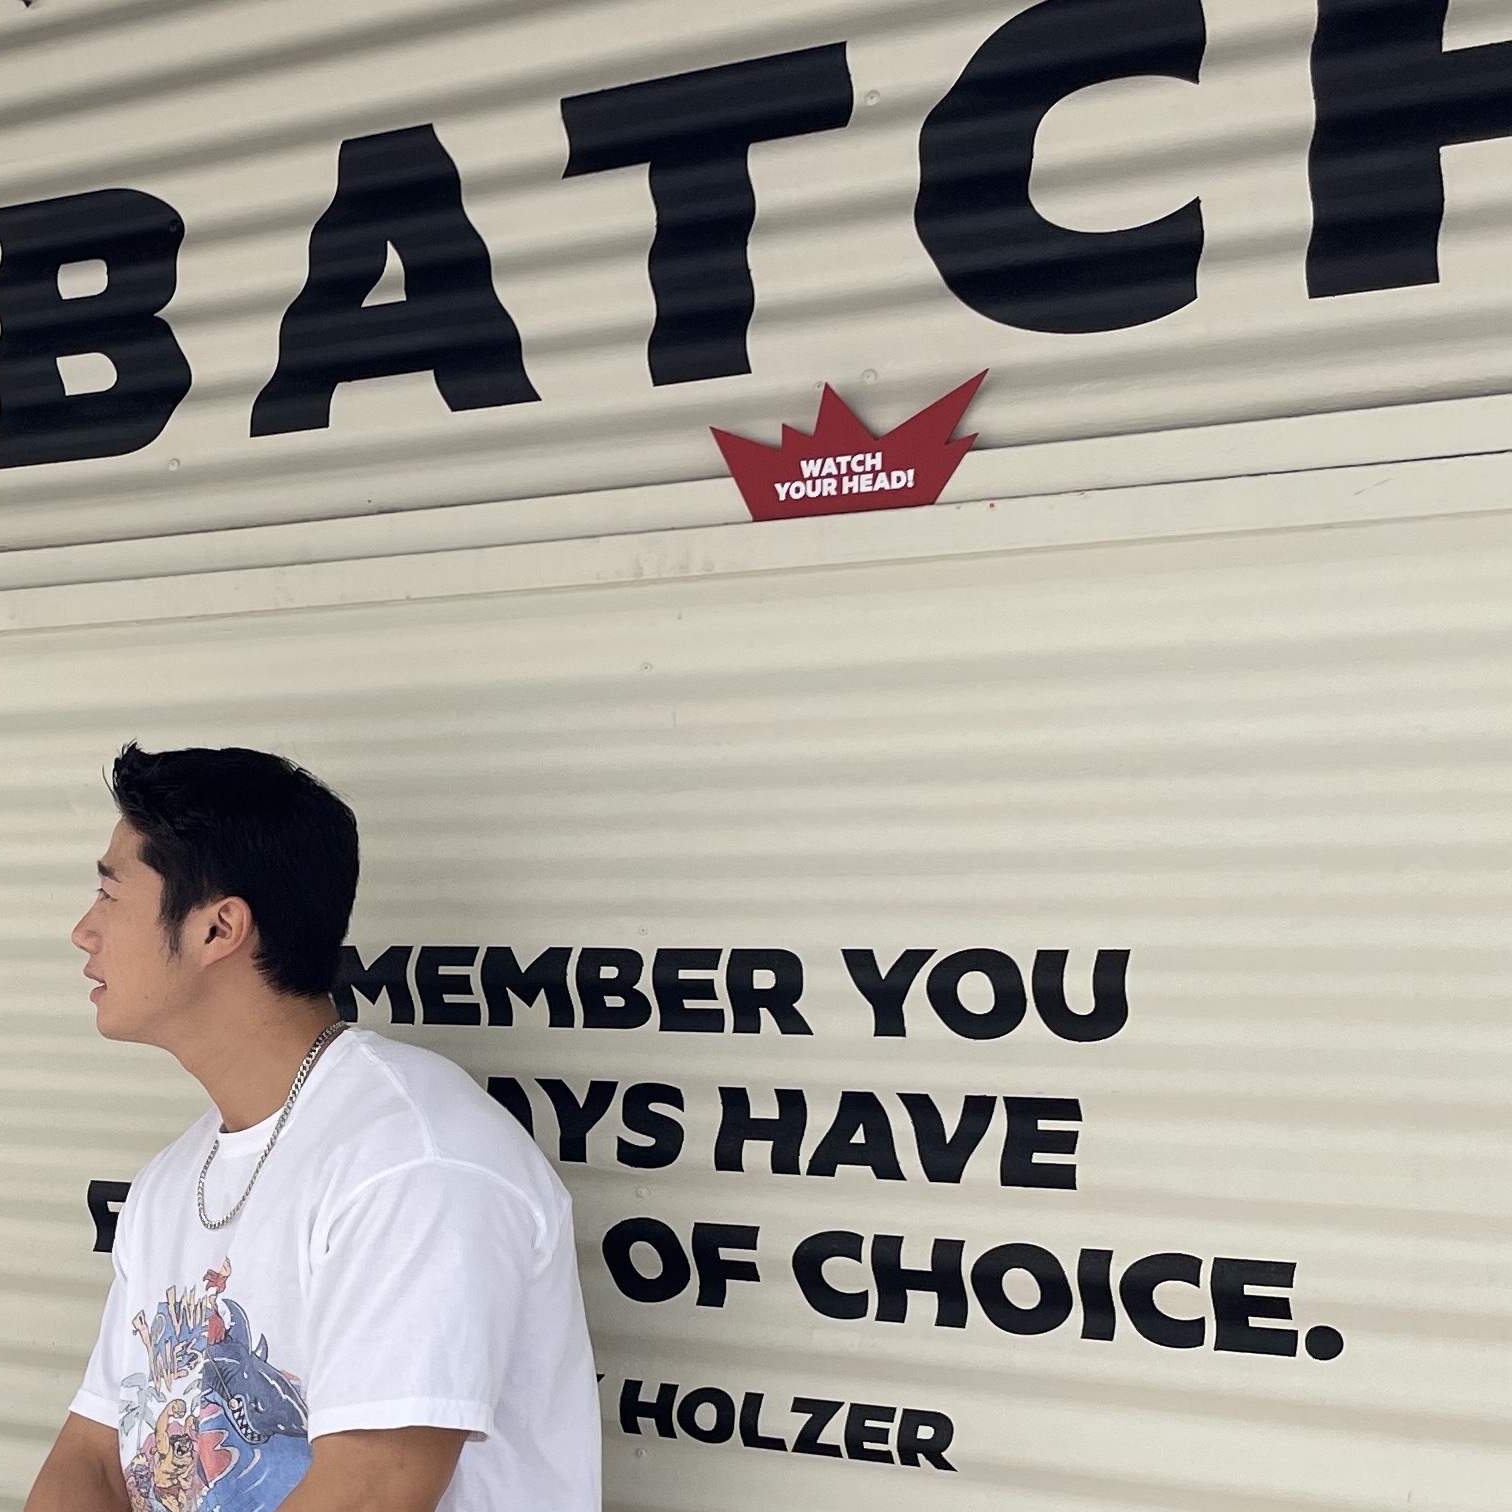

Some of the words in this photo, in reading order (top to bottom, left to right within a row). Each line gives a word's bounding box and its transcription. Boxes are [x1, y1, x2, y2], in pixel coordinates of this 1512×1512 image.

[774, 480, 838, 501] YOUR
[841, 468, 914, 494] HEAD!
[800, 452, 882, 478] WATCH
[841, 948, 1131, 1042] YOU
[714, 1087, 1082, 1190] HAVE
[602, 1217, 760, 1308] OF
[792, 1231, 1343, 1360] CHOICE.
[619, 1379, 957, 1472] HOLZER
